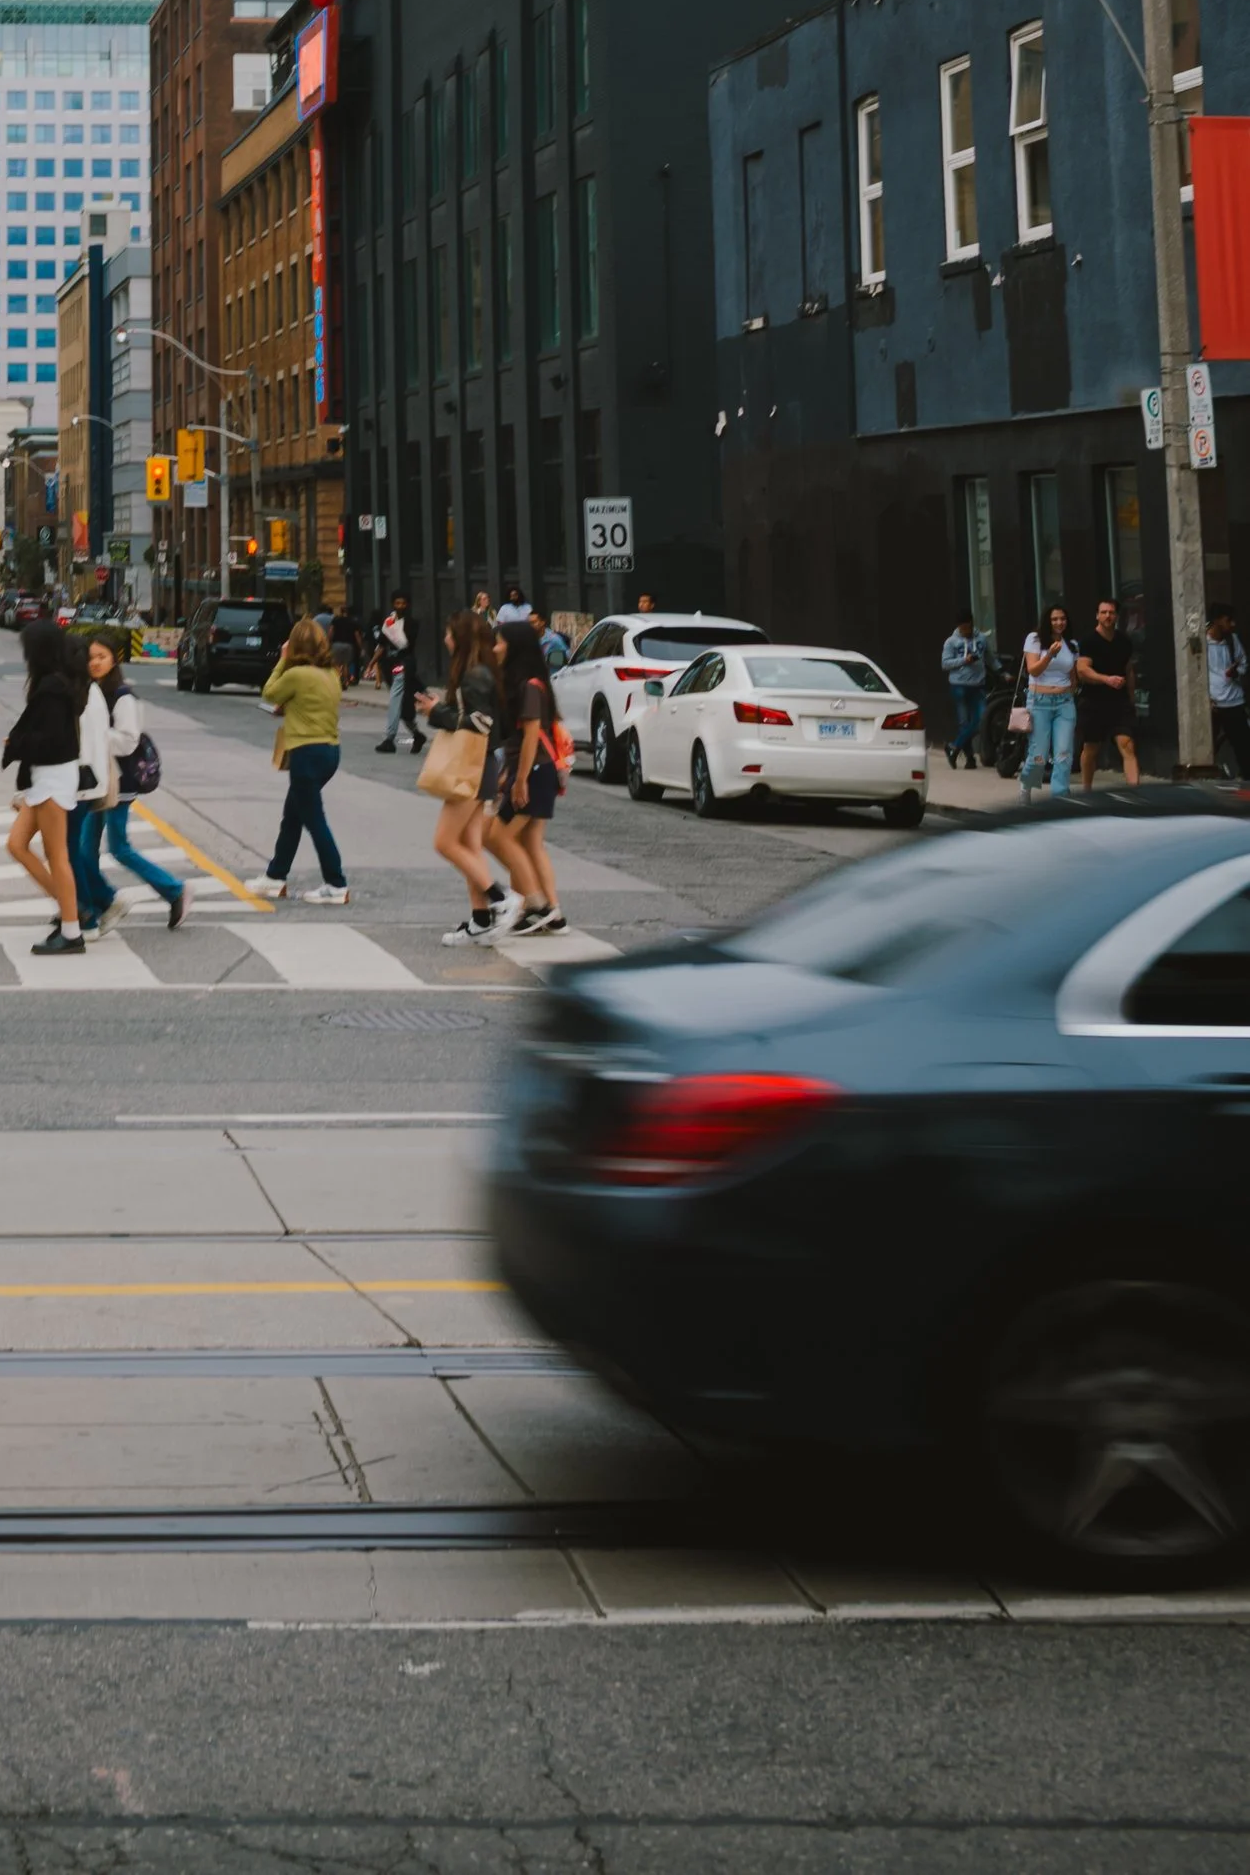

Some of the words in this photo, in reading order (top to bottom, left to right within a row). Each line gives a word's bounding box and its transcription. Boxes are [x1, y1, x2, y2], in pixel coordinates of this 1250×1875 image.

[589, 505, 628, 514] MAXIMUM
[591, 523, 628, 549] 30
[591, 556, 630, 571] BEGINS
